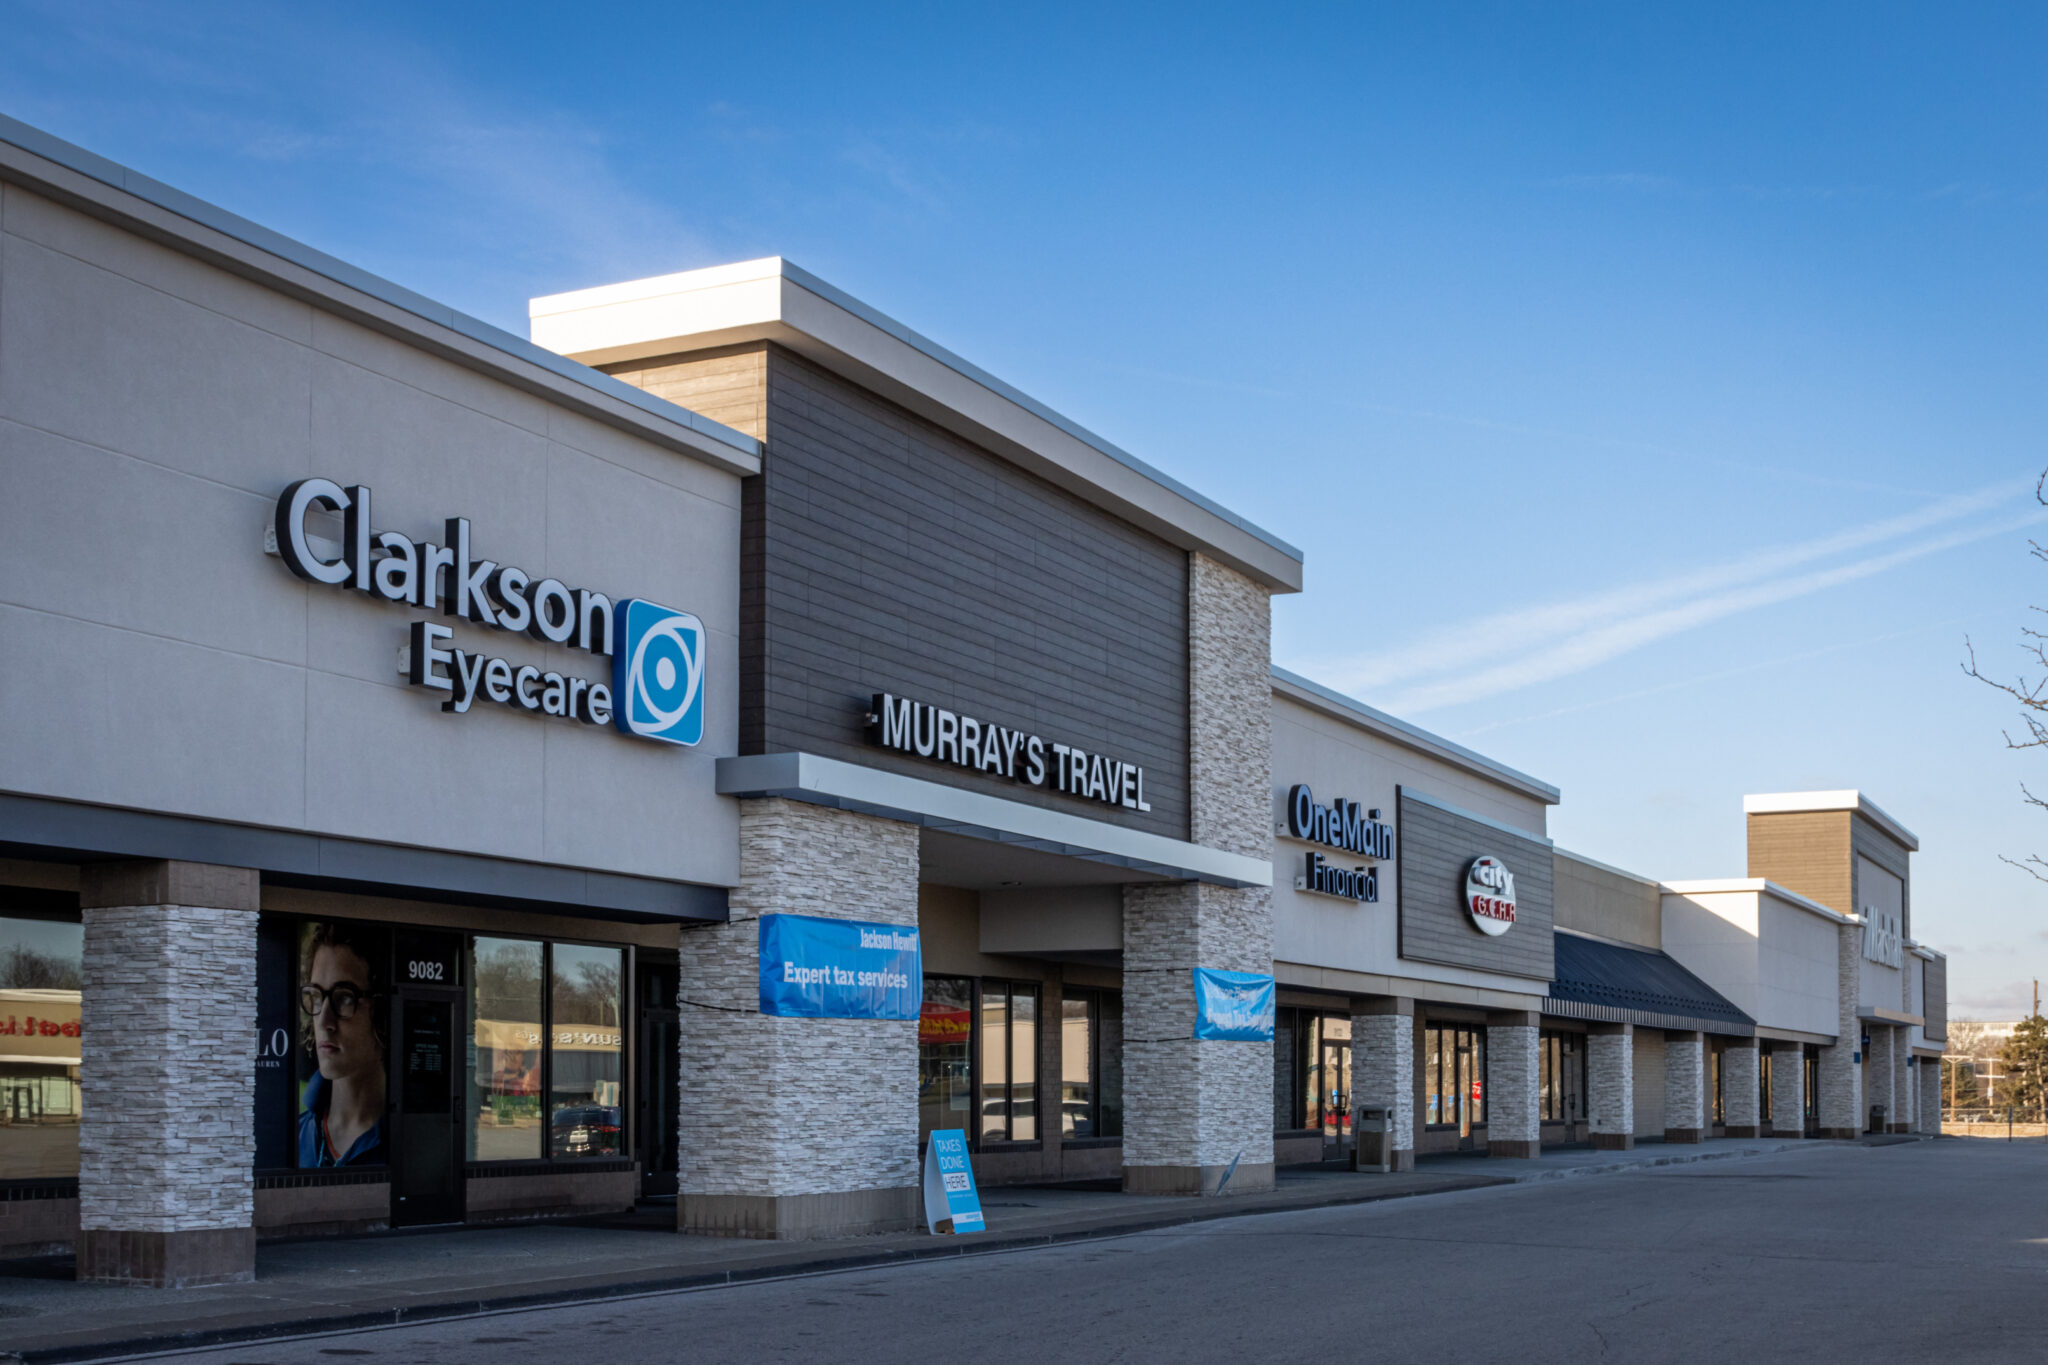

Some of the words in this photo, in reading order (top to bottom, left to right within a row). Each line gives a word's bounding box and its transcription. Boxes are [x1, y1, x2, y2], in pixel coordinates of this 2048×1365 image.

[277, 477, 613, 655] Clarkson
[411, 620, 613, 726] Eyecare
[876, 692, 1046, 786] MURRAY'S
[1050, 742, 1151, 812] TRAVEL
[1289, 783, 1394, 860] OneMain
[860, 927, 893, 950] Jackson
[408, 960, 444, 980] 9082
[783, 961, 831, 989] Expert
[833, 965, 856, 986] tax
[857, 967, 908, 989] services
[936, 1139, 962, 1153] TAXES
[940, 1156, 965, 1170] DONE
[944, 1174, 968, 1190] HERE
